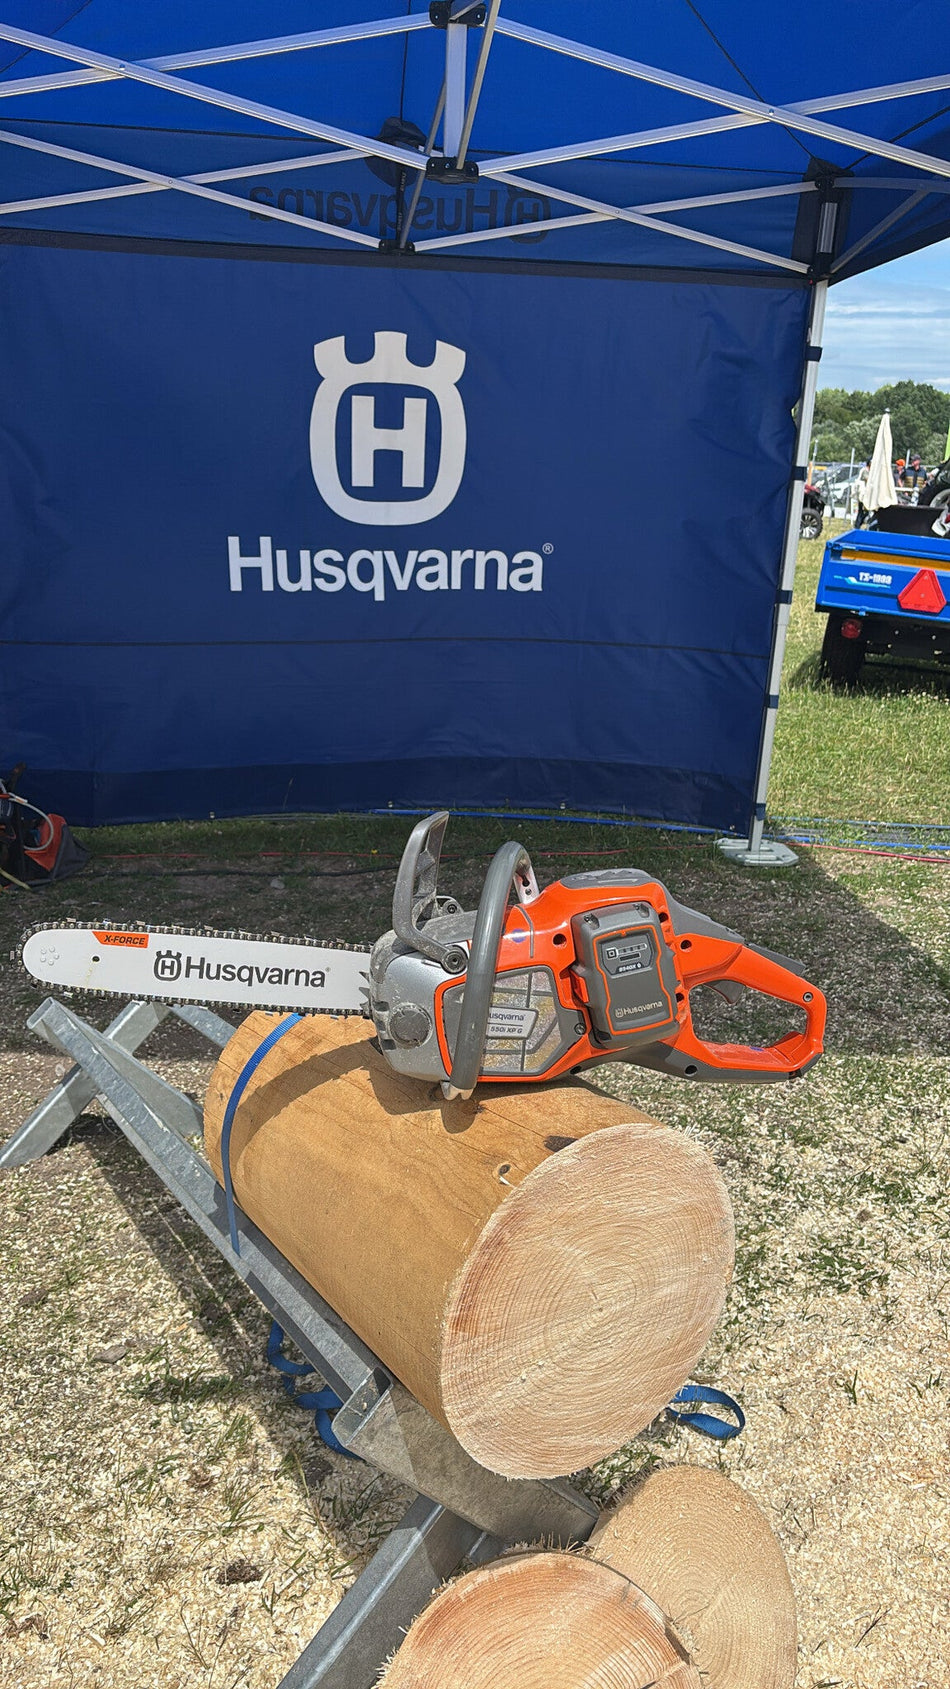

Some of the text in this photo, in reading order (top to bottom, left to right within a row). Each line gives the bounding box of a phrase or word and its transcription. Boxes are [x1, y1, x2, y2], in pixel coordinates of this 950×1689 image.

[103, 934, 146, 946] X-FORCE
[185, 956, 327, 988] Husqvarna
[624, 1001, 663, 1015] Husqvarna
[489, 1013, 525, 1021] usqvarna
